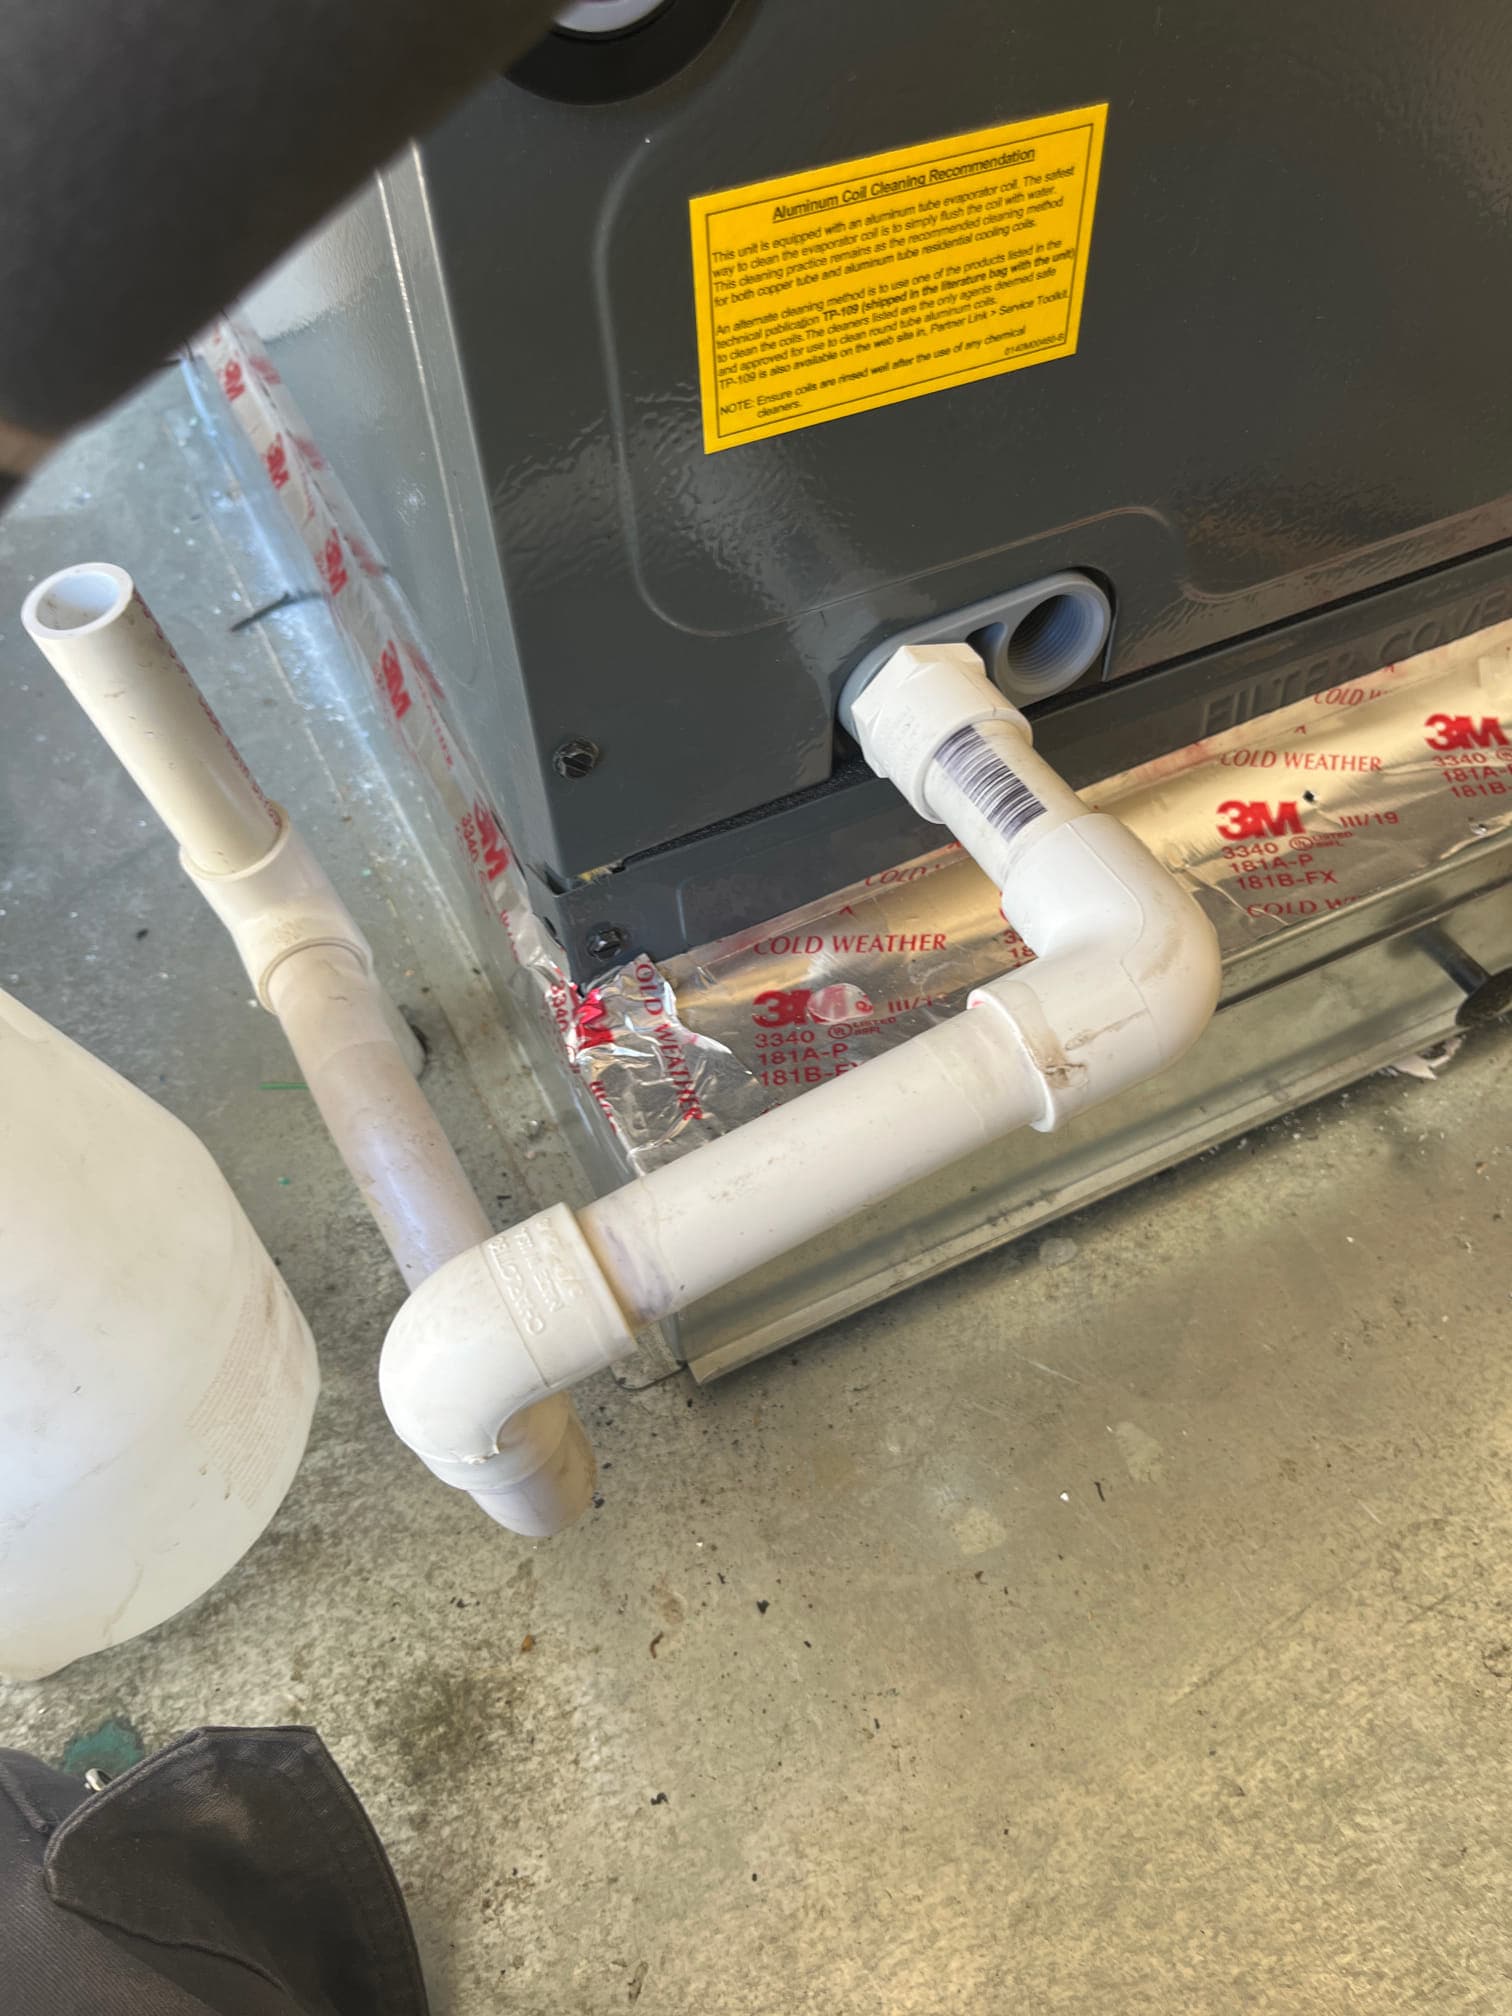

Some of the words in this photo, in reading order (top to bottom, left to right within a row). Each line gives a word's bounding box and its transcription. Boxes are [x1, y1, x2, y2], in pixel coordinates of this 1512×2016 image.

[773, 192, 838, 220] Aluminum
[842, 186, 865, 203] Coil
[870, 172, 926, 199] Cleaning
[928, 146, 1035, 183] Recommendation
[1424, 713, 1511, 751] 3M
[1220, 750, 1277, 768] COLD
[1284, 751, 1383, 772] WEATHER
[1216, 800, 1306, 841] 3M
[1222, 842, 1279, 859] 3340
[1229, 854, 1313, 873] 181A-P
[1237, 870, 1338, 891] 181B-FX
[1247, 900, 1317, 918] COLD
[754, 934, 823, 955] COLD
[832, 933, 947, 953] WEATHER
[635, 963, 663, 1016] OLD
[754, 1030, 816, 1049] 3340
[757, 1043, 848, 1066] 181A-P
